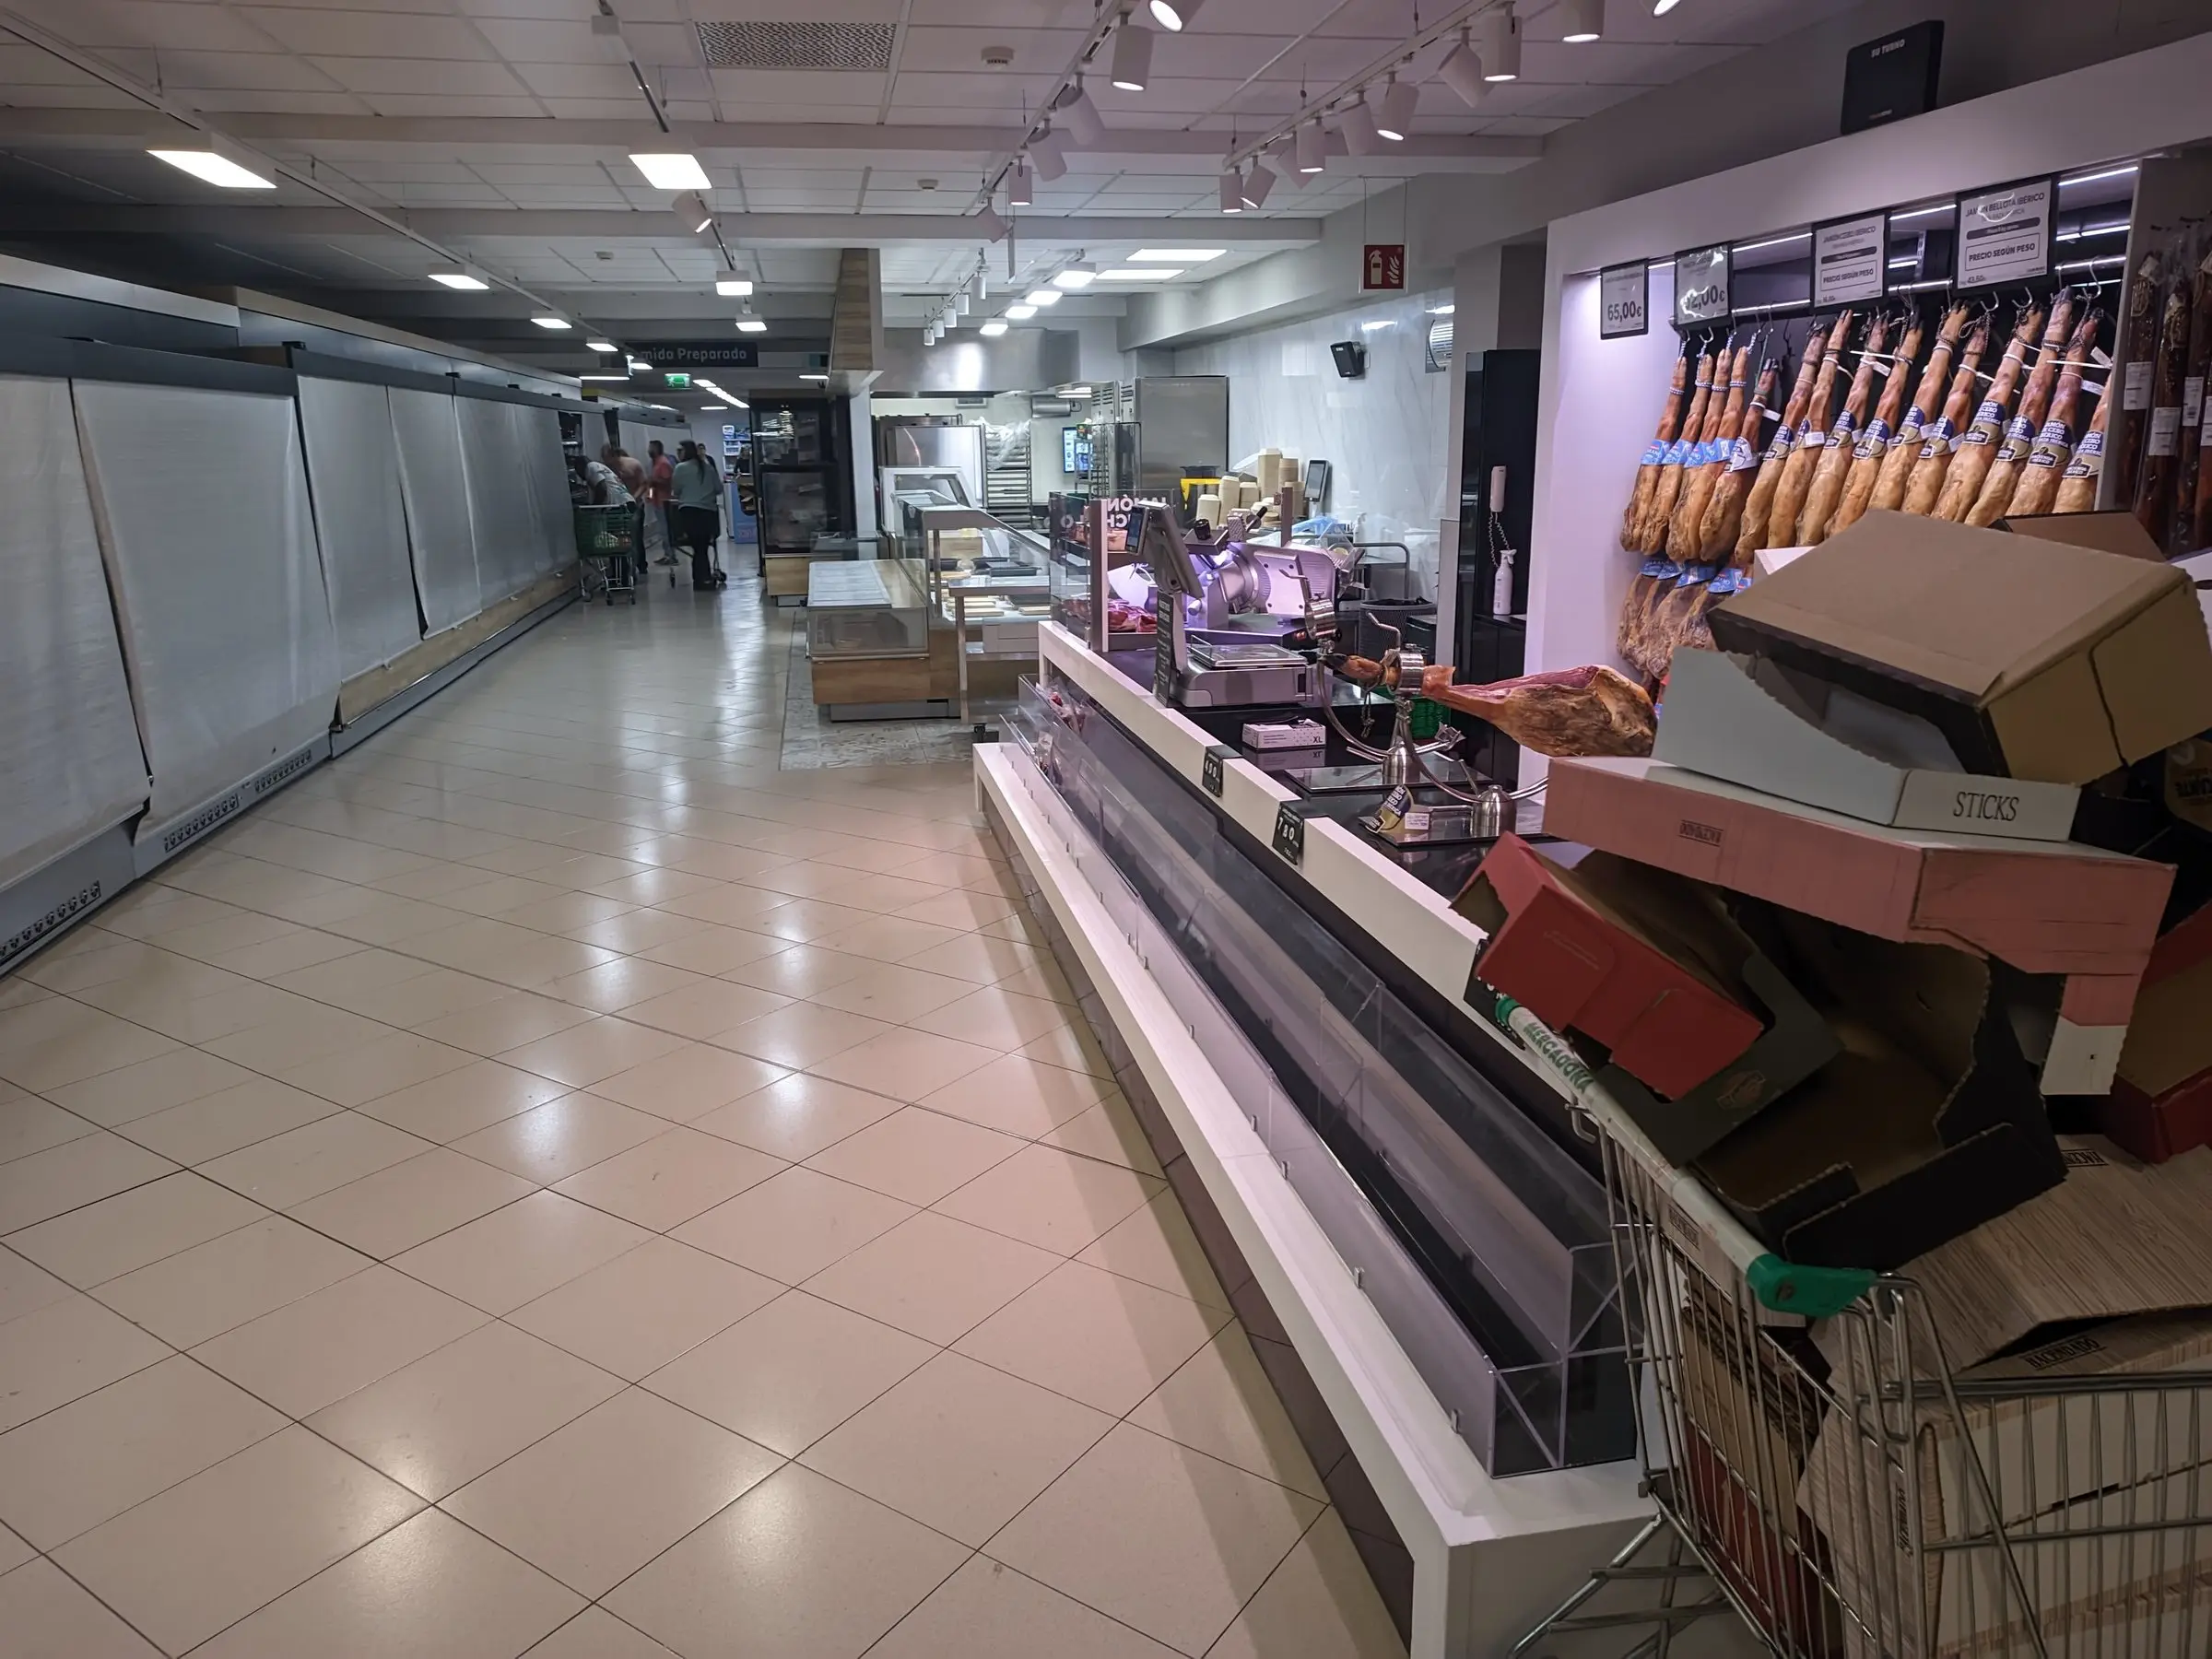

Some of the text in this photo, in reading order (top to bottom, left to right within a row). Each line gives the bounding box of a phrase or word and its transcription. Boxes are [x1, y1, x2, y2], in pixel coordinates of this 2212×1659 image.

[1966, 206, 1988, 217] JAMN
[1969, 242, 2036, 262] PRECIO SEGÚN PESO
[677, 347, 747, 362] Preparado
[1312, 735, 1323, 744] XL
[1953, 791, 2019, 821] STICKS
[1524, 1021, 1594, 1095] MERCADONA
[2025, 1337, 2100, 1369] HACENDADO
